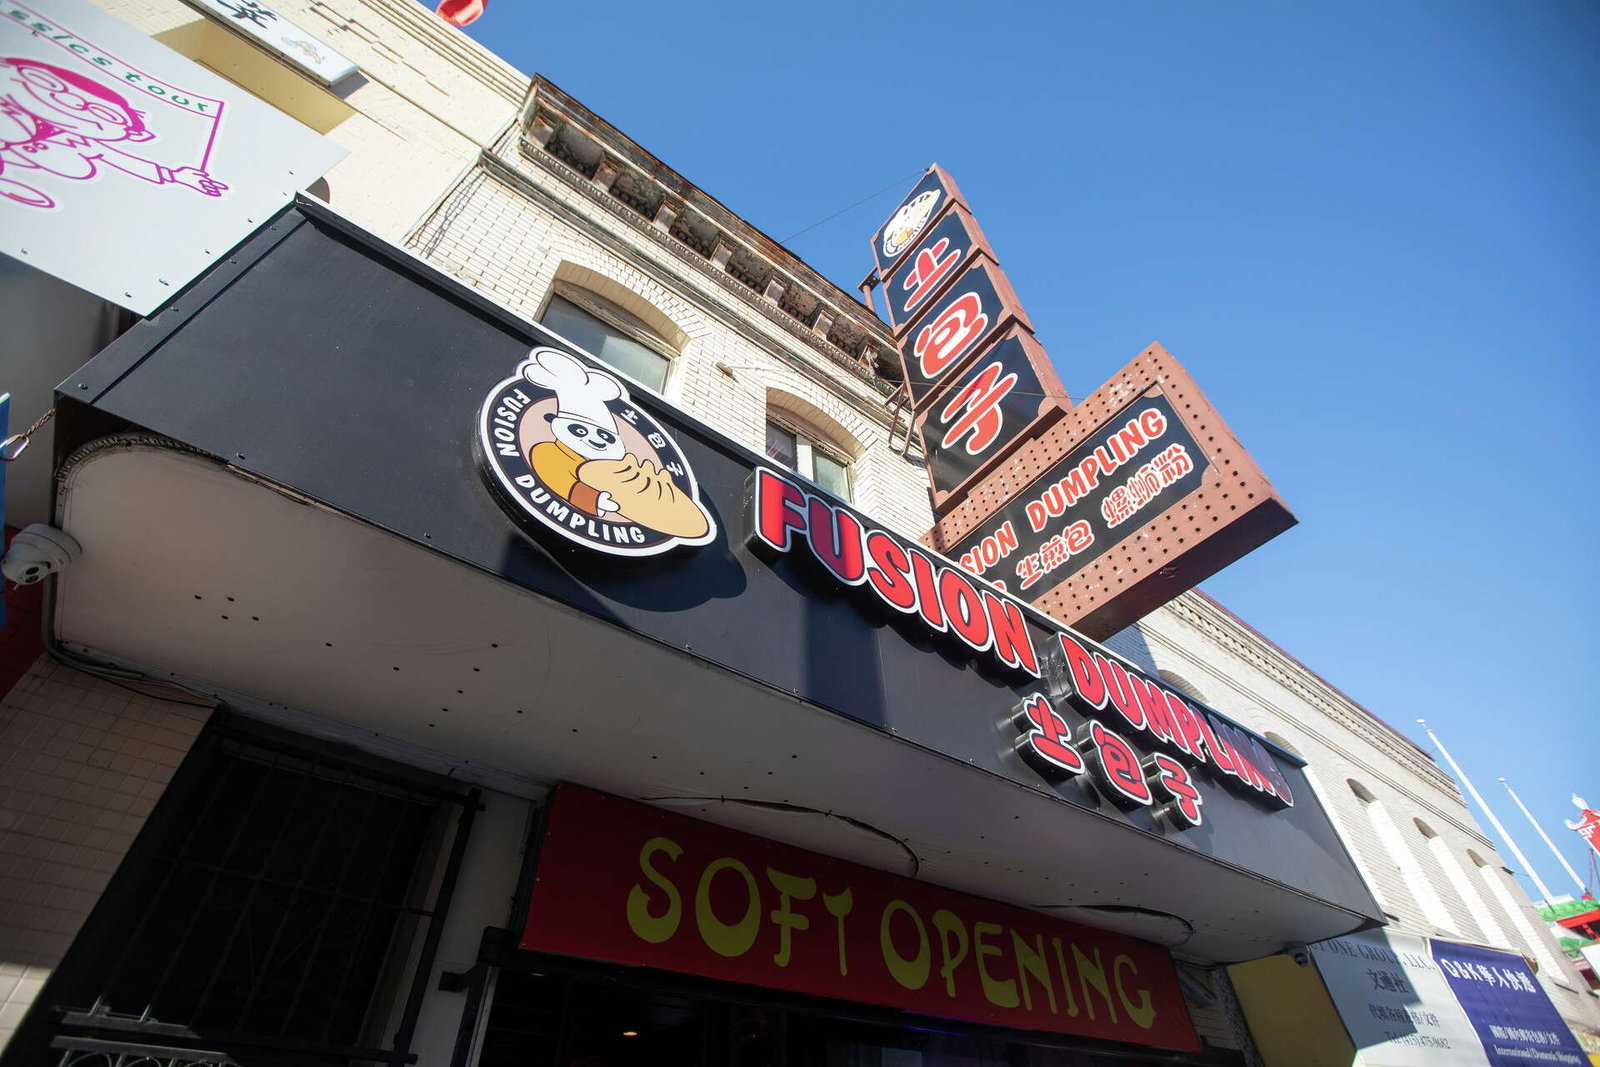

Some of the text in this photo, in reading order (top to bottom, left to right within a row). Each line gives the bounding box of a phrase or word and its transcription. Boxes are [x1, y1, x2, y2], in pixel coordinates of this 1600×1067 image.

[0, 0, 209, 113] ssics tour
[902, 236, 1019, 456] 土包子
[494, 388, 532, 457] FUSION
[621, 408, 684, 477] 土包子
[515, 474, 646, 544] DUMPLING
[960, 406, 1168, 576] SION DUMPLING
[1015, 519, 1096, 590] 生煎包
[755, 465, 1295, 808] FUSION DUMPLING
[1024, 692, 1204, 828] 土包子
[626, 836, 1158, 1030] SOFT OPENING
